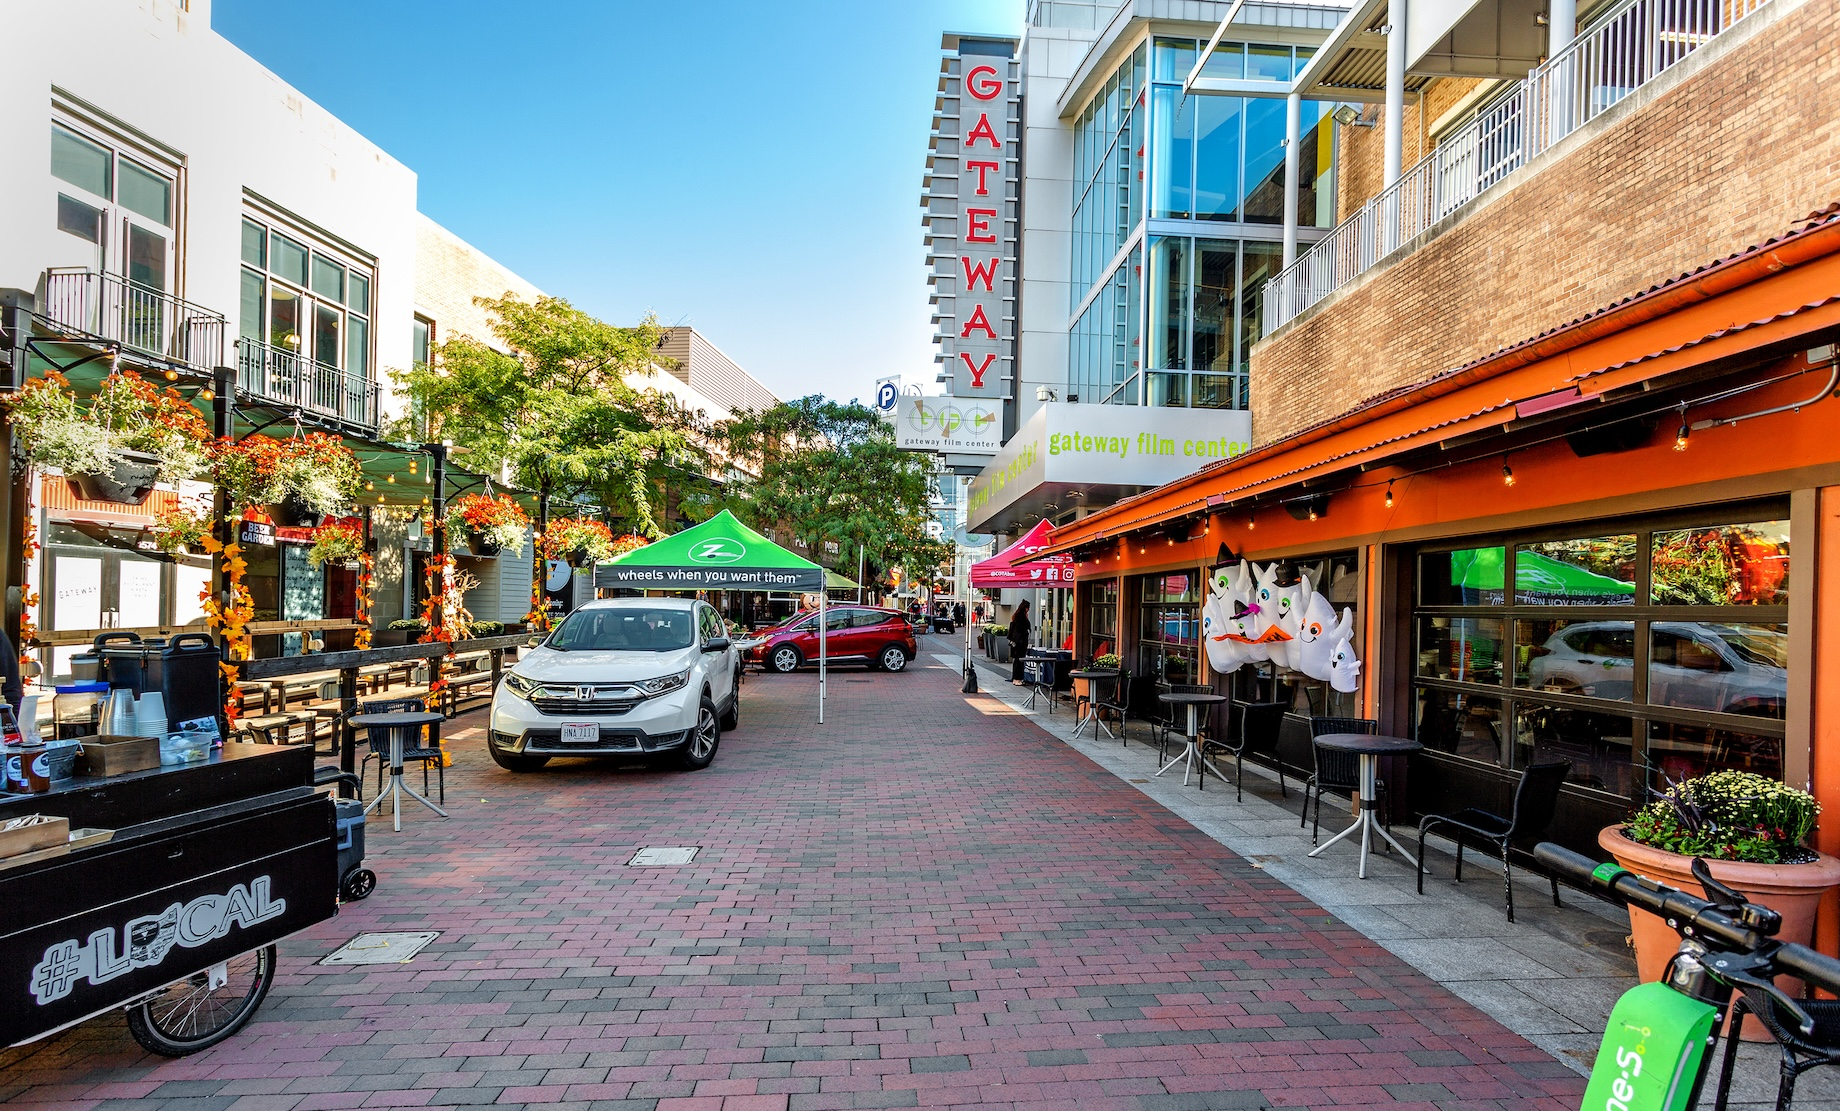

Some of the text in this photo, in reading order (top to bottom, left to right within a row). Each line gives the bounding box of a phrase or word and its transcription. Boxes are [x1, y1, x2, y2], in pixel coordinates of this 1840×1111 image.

[960, 65, 1003, 389] GATEWAY
[904, 437, 995, 449] gateway film center
[1049, 430, 1249, 459] gateway film center
[247, 522, 270, 535] BEER
[241, 531, 275, 546] GARDEN
[617, 569, 664, 581] wheels
[666, 569, 702, 581] when
[704, 571, 727, 584] you
[730, 571, 762, 582] want
[58, 586, 98, 600] GATEWAY
[563, 727, 596, 738] HNA 7117
